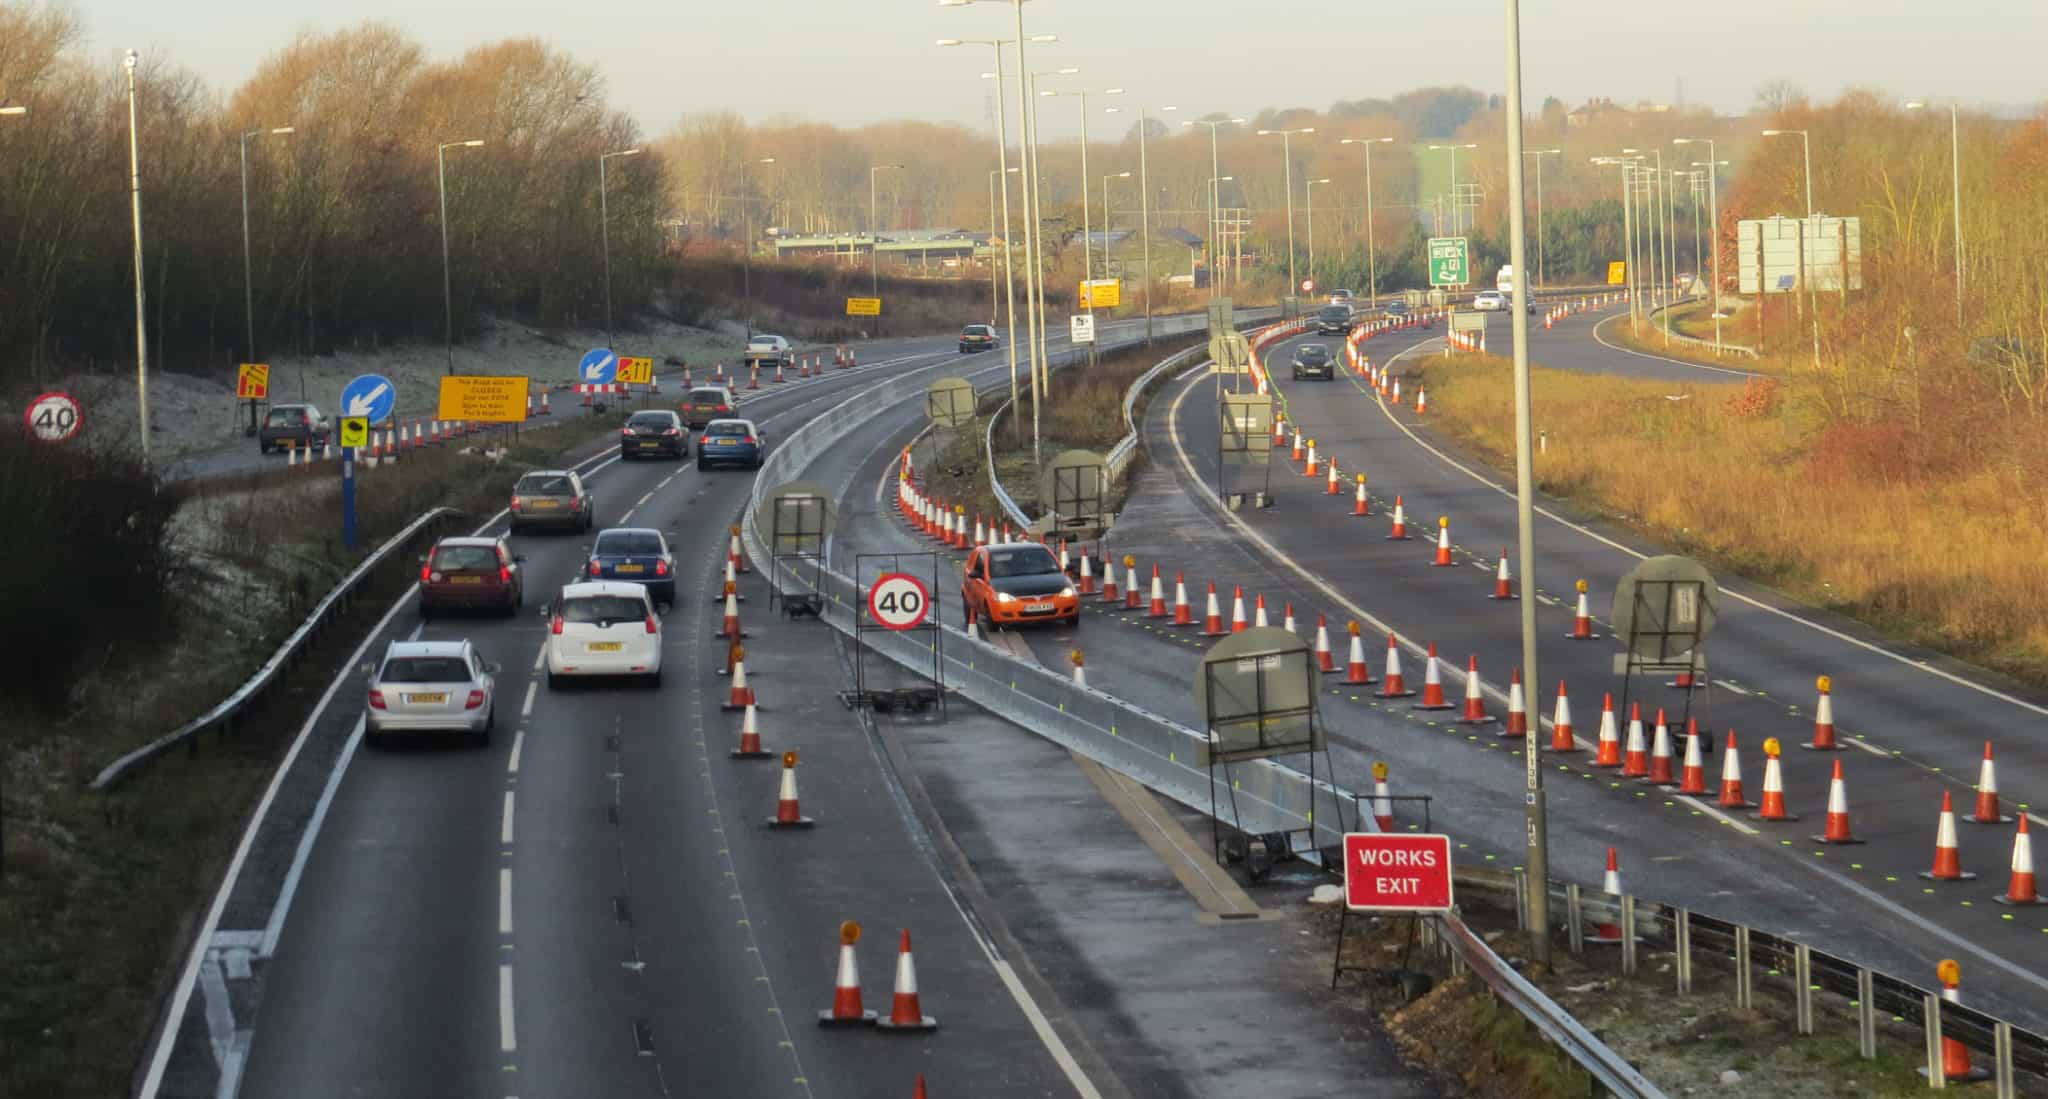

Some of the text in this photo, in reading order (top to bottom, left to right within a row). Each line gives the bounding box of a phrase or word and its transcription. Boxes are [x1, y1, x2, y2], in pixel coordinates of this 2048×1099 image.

[35, 407, 75, 429] 40
[879, 591, 920, 613] 40
[1358, 849, 1436, 867] WORKS
[1376, 877, 1421, 894] EXIT
